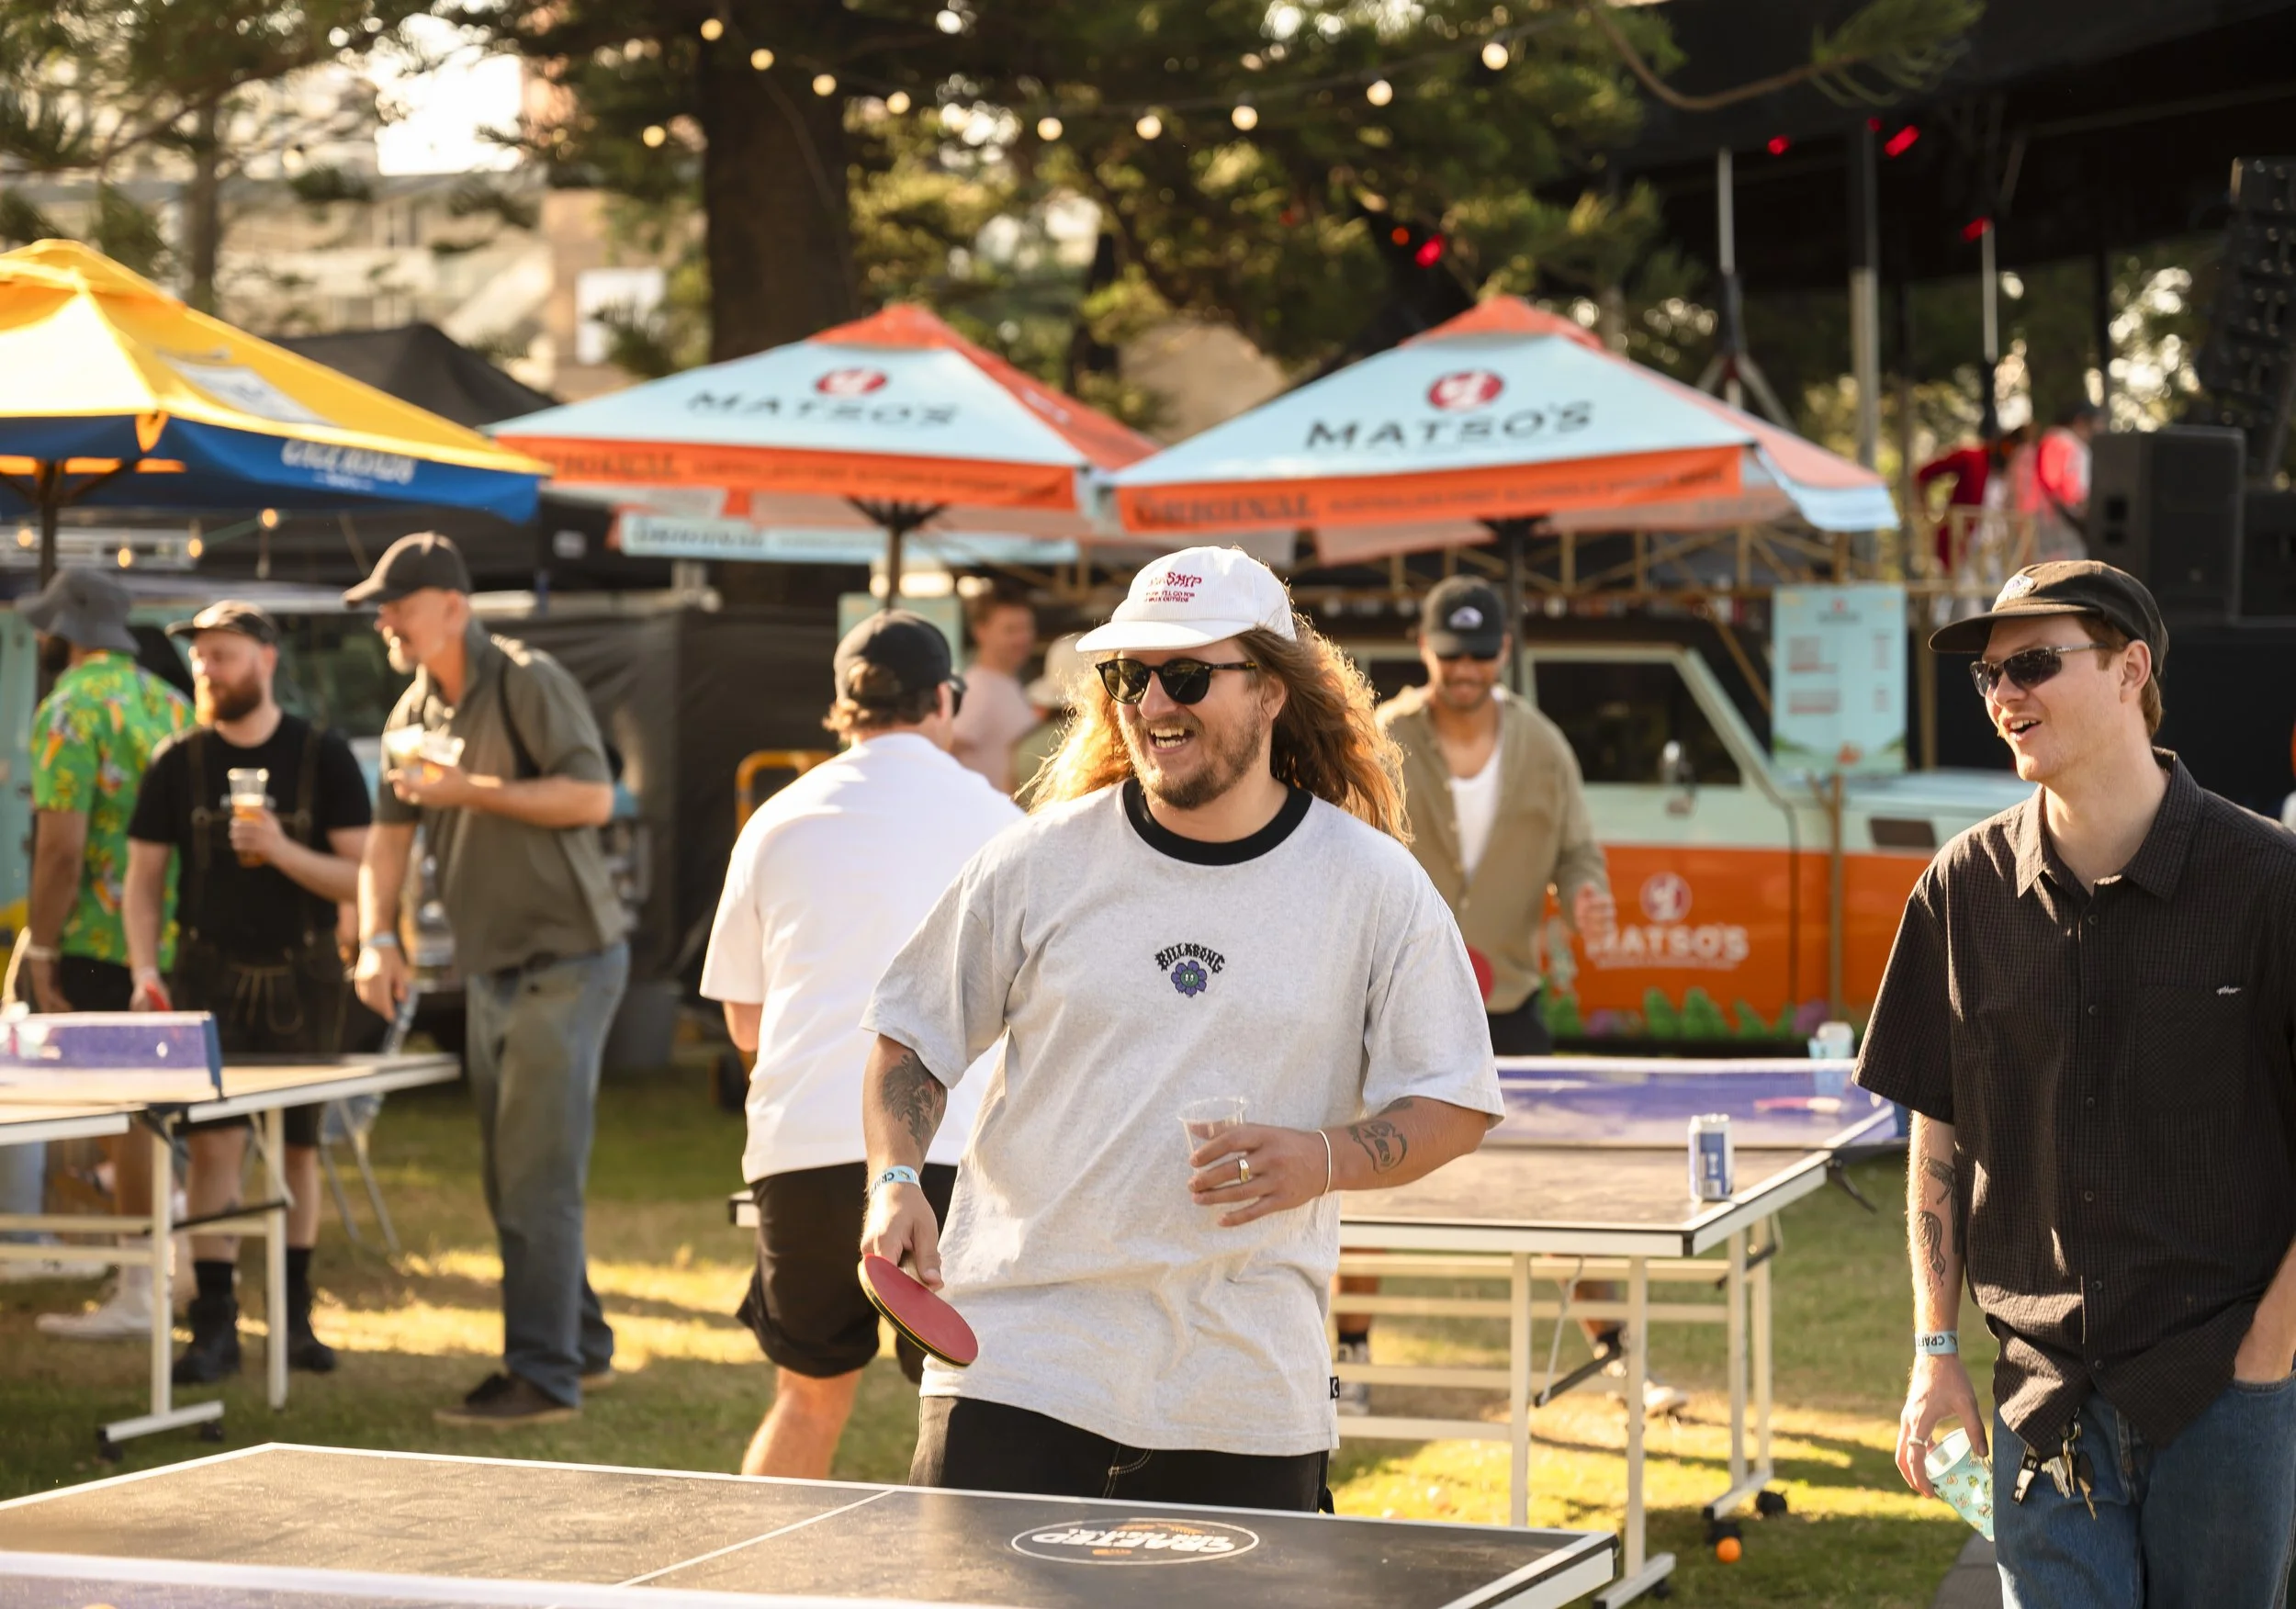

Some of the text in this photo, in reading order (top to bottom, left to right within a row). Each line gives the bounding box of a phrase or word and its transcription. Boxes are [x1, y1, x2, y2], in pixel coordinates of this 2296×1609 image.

[1305, 400, 1594, 449] MATSO'S
[1154, 942, 1225, 974] BILLABONG
[1031, 1531, 1235, 1553] CRAFTED
